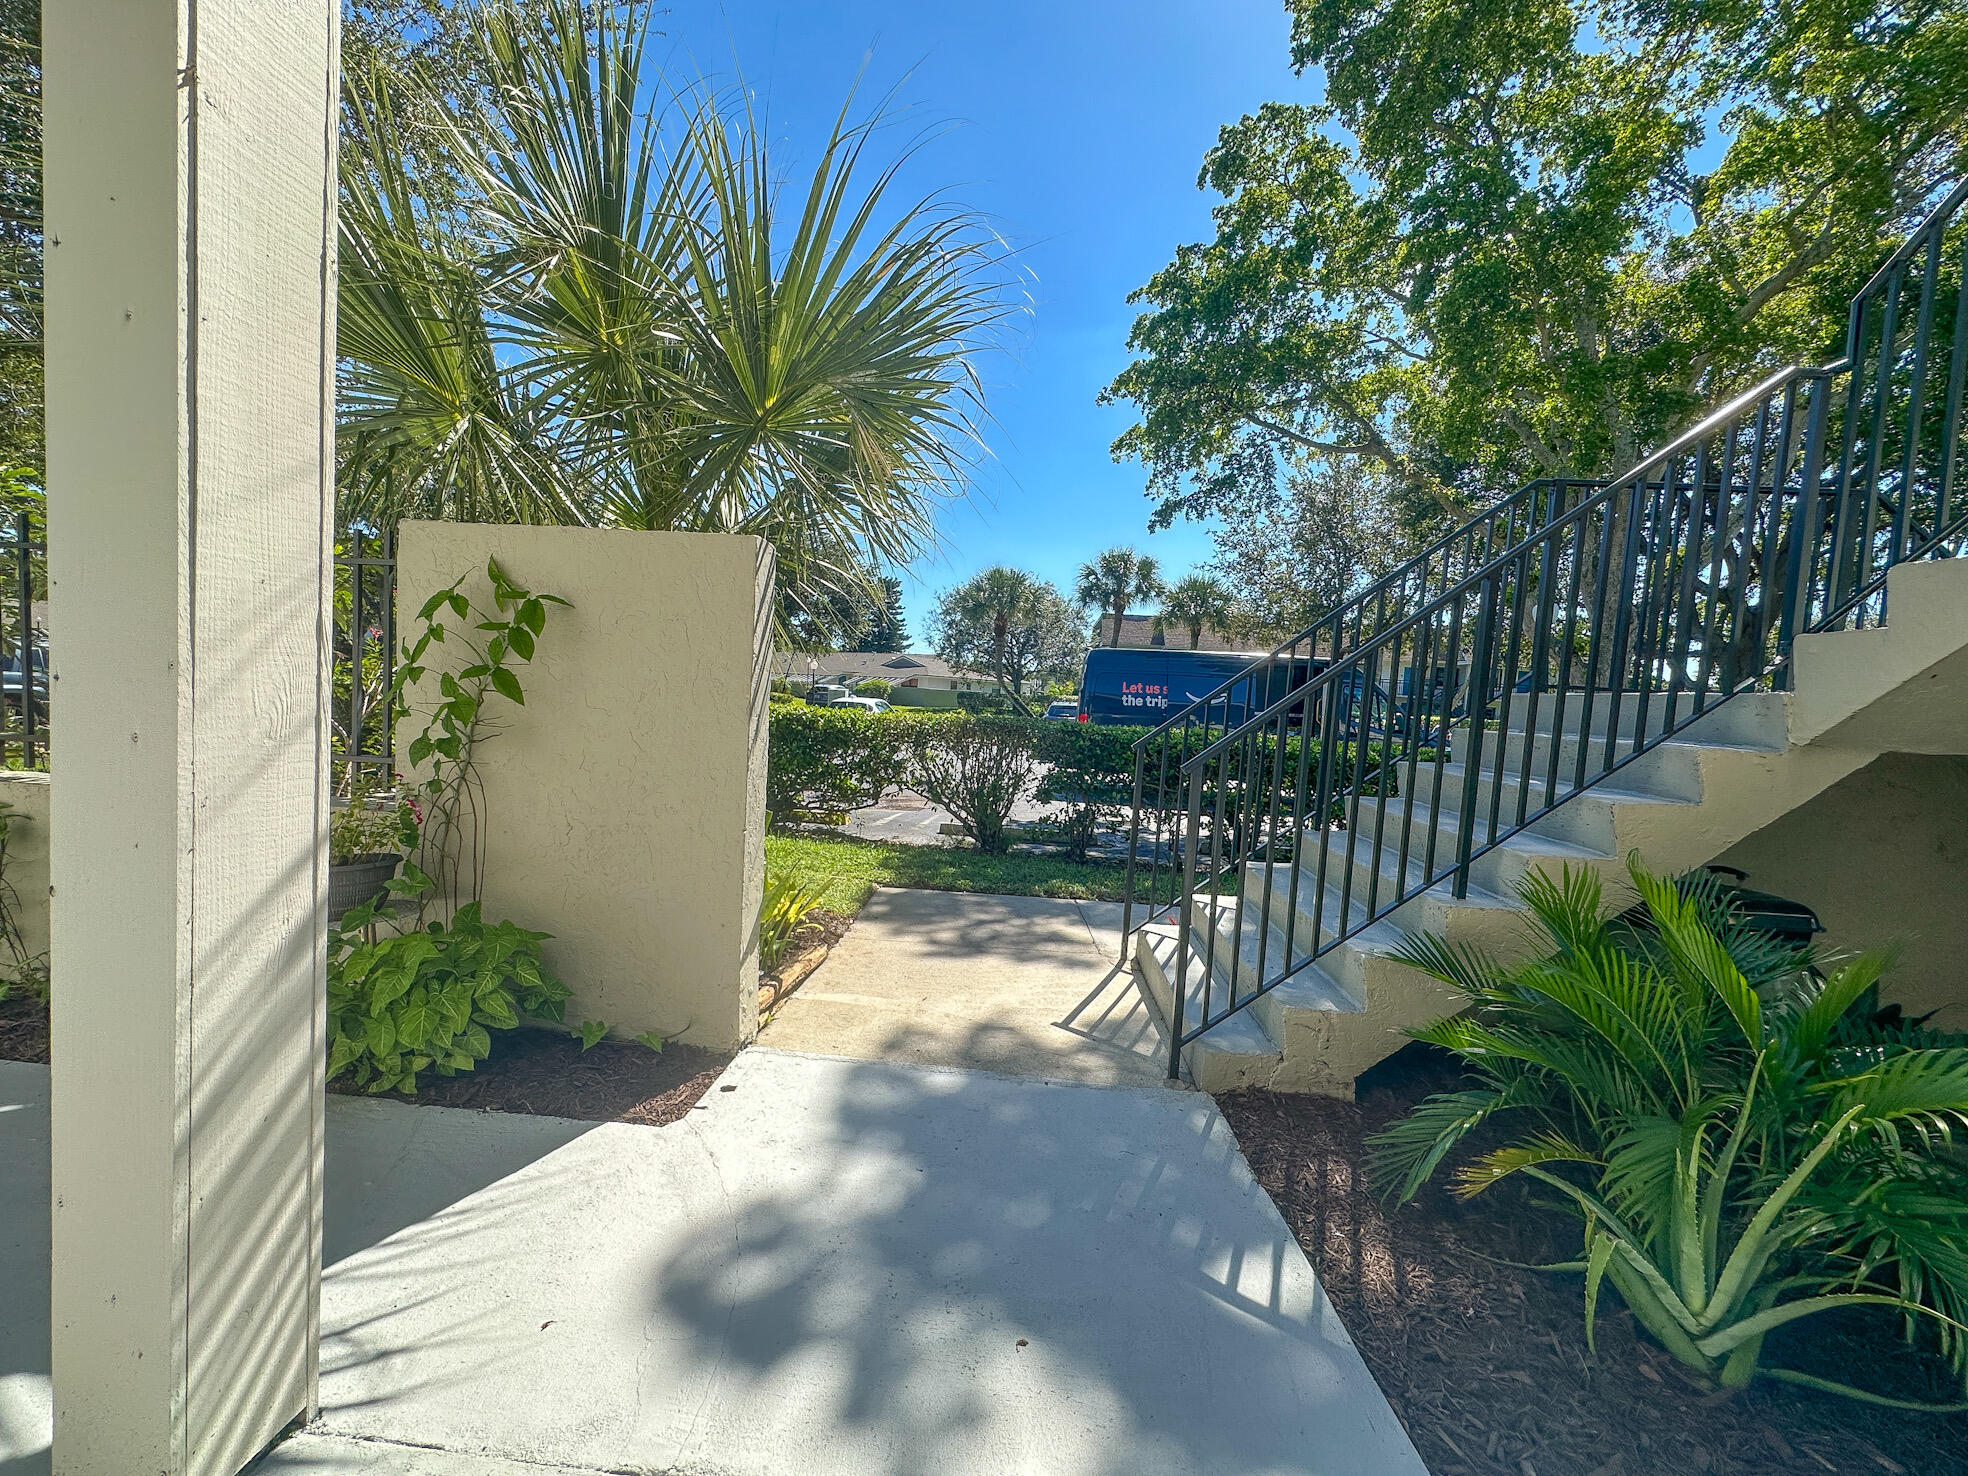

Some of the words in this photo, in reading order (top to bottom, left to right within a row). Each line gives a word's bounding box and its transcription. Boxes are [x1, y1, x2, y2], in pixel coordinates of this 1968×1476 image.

[1122, 681, 1143, 693] Let
[1145, 685, 1160, 694] us
[1122, 694, 1143, 706] the
[1145, 695, 1168, 709] trip
